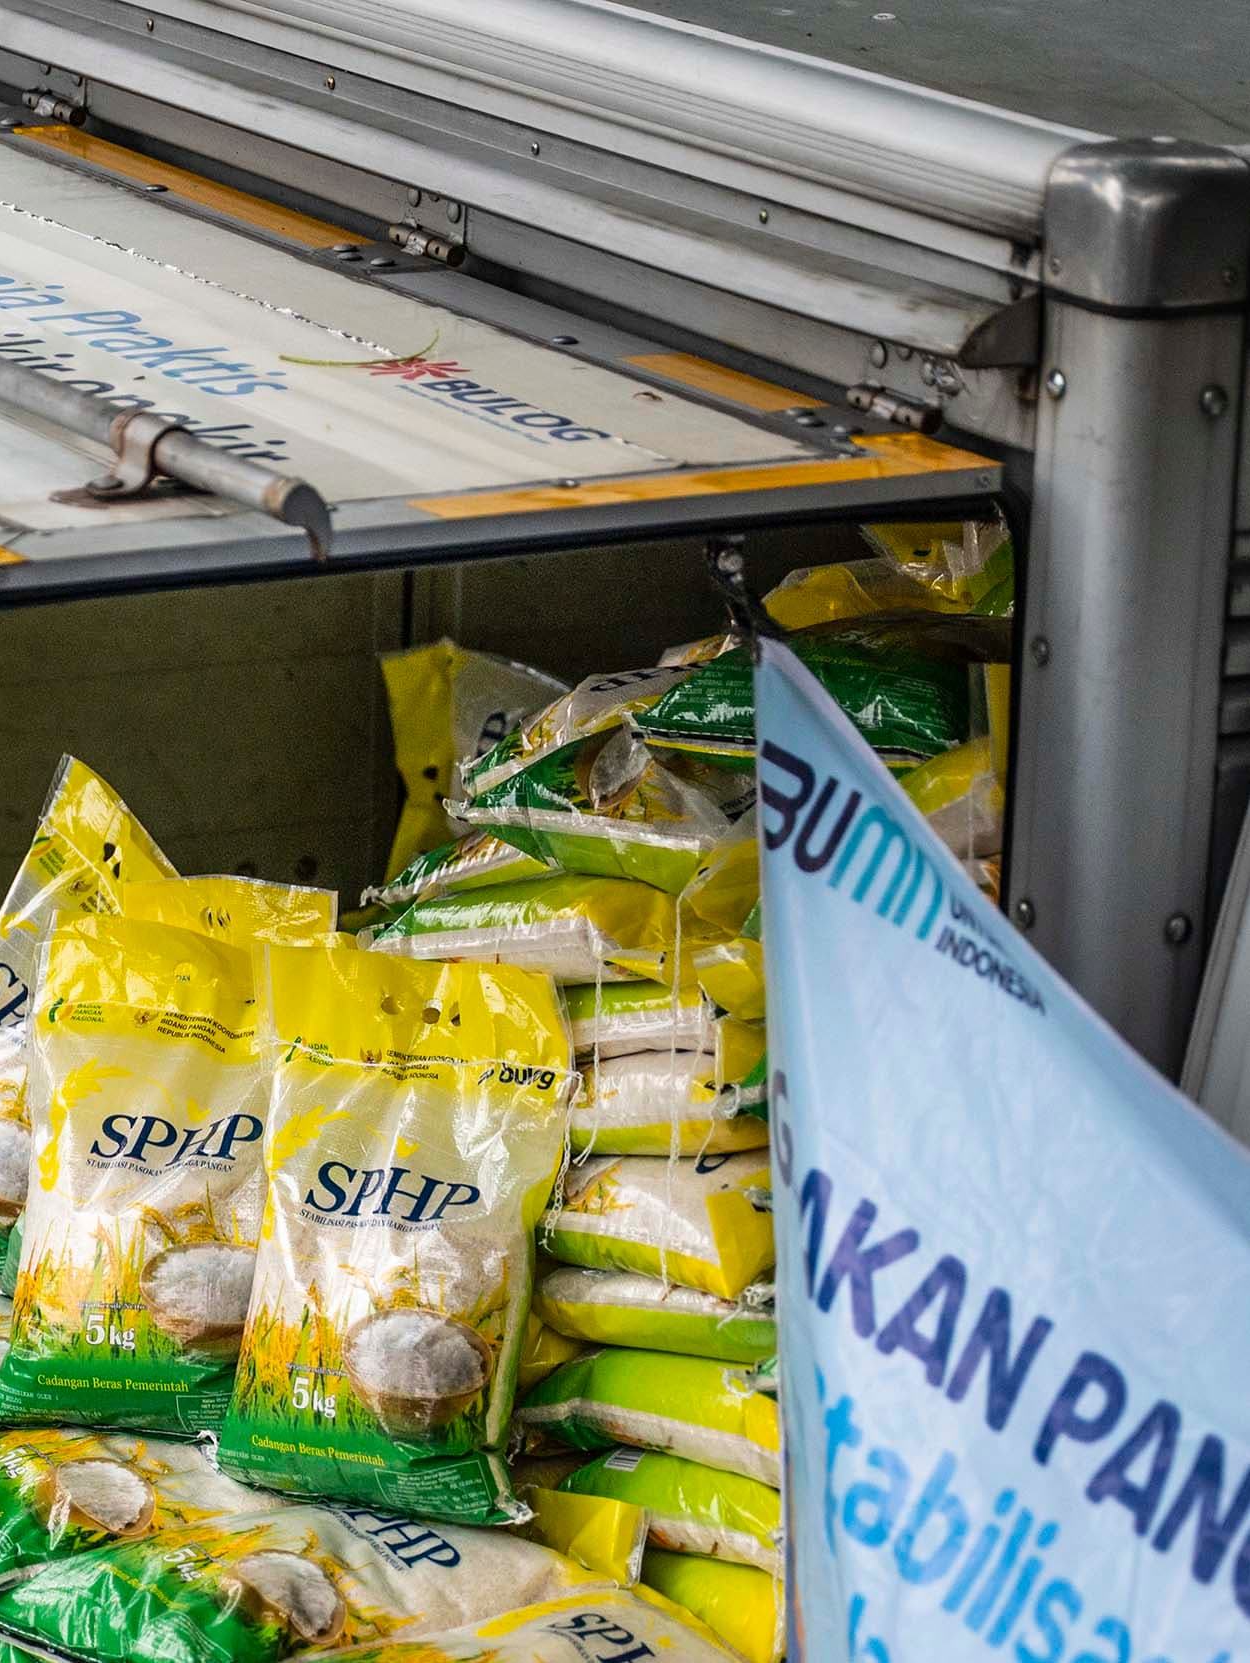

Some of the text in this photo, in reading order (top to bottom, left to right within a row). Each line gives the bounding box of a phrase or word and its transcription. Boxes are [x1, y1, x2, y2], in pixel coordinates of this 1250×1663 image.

[28, 310, 288, 396] Praktis
[418, 379, 612, 441] BULOG
[156, 1025, 226, 1053] REPUBLIK INDONESIA
[160, 1018, 217, 1037] BIDANG PANGAN
[164, 1011, 255, 1040] KEMENTERIAN KOORDINATOR
[498, 1062, 556, 1090] bulog
[90, 1114, 264, 1167] SPHP
[200, 1161, 234, 1173] PANGAN
[304, 1161, 481, 1223] SPHP
[300, 1208, 346, 1228] STABILISASI
[86, 1314, 136, 1350] 5 kg
[37, 1375, 190, 1393] Cadangan Beras Pemerintah
[292, 1377, 336, 1419] 5 kg
[251, 1434, 386, 1467] Cadangan Beras Pemerintah
[1032, 1351, 1250, 1622] PAN
[317, 1500, 461, 1568] PHP
[163, 1547, 198, 1562] 5
